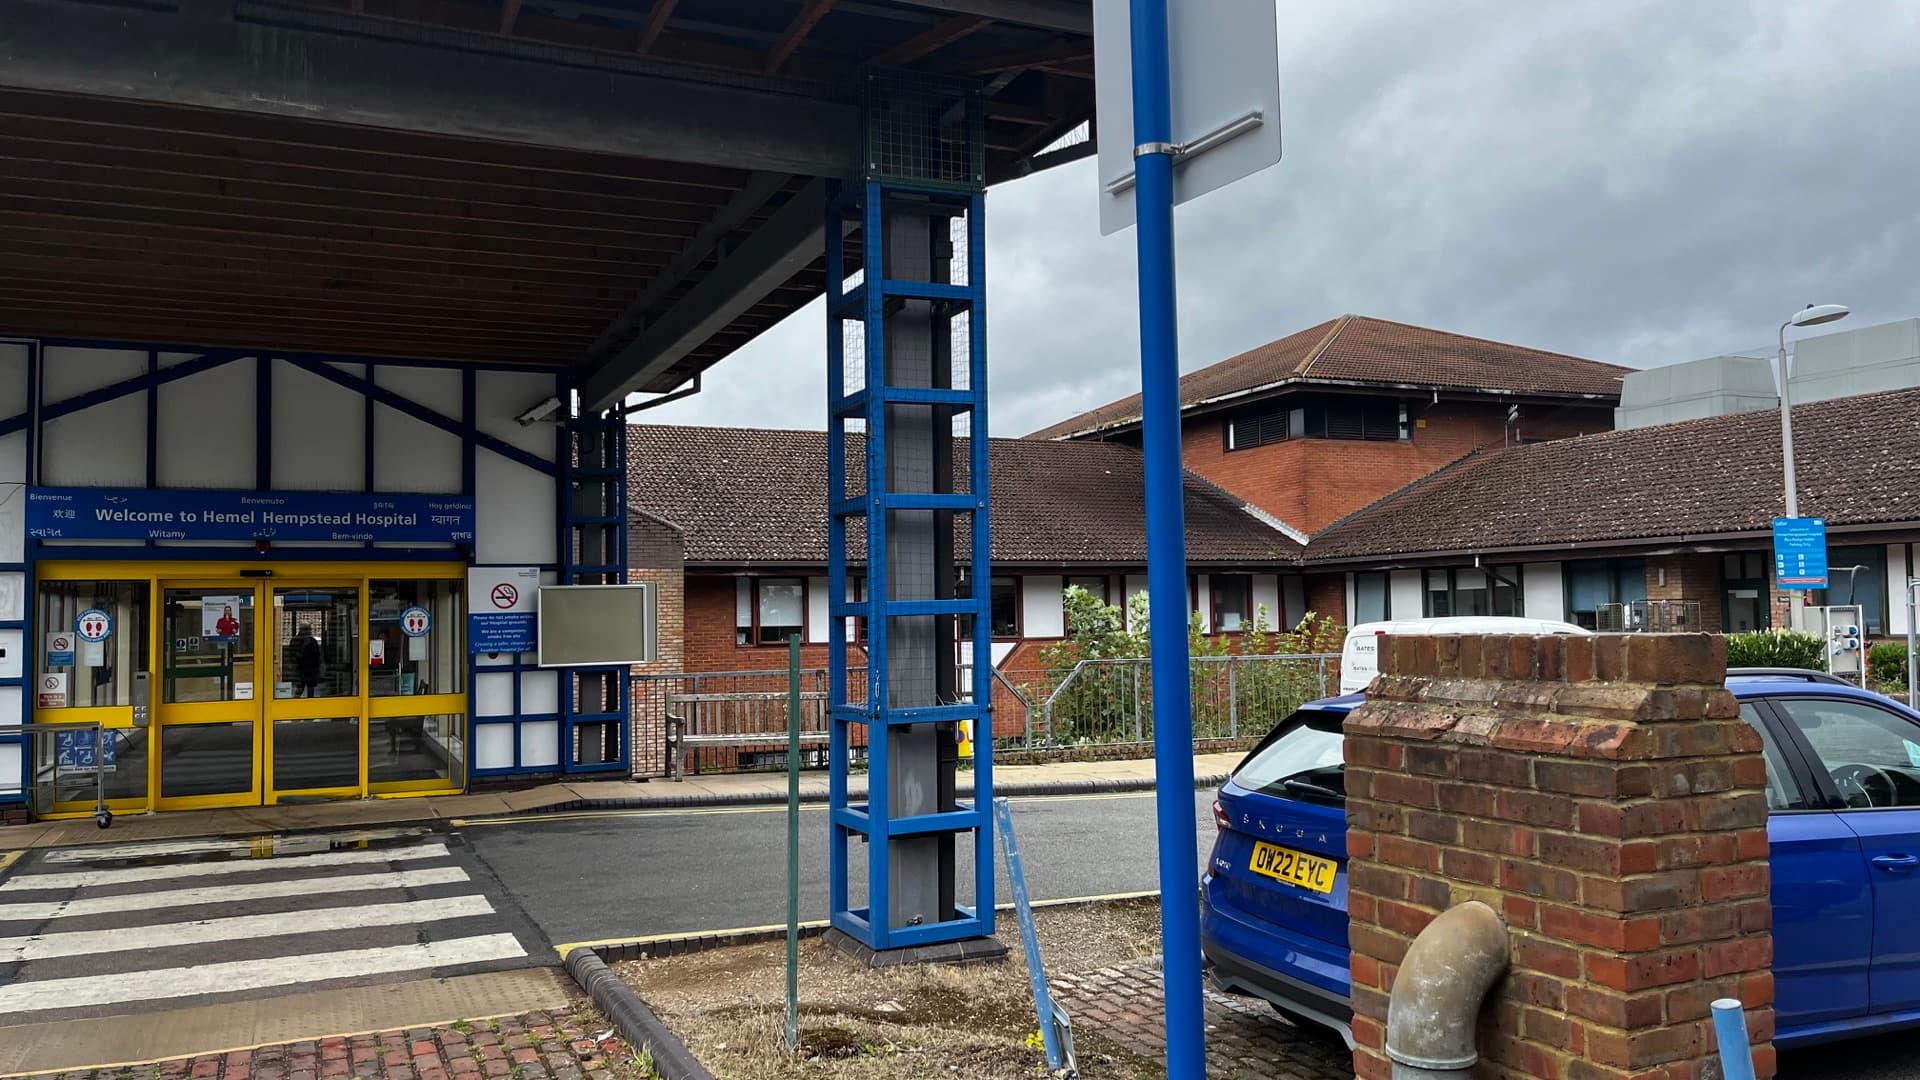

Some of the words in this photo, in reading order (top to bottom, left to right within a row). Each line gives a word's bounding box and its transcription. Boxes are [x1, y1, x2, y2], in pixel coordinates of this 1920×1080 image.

[30, 493, 73, 501] Bienvenue
[241, 496, 285, 505] Benvenuto
[95, 508, 174, 523] Welcome
[179, 510, 197, 523] to
[203, 510, 255, 524] Hemel
[263, 511, 351, 527] Hempstead
[356, 512, 417, 528] Hospital
[431, 514, 461, 526] स्वागत
[149, 529, 186, 540] Witamy
[332, 531, 373, 540] Bem-vindo
[1256, 847, 1294, 877] OW22
[1294, 856, 1328, 887] EYC
